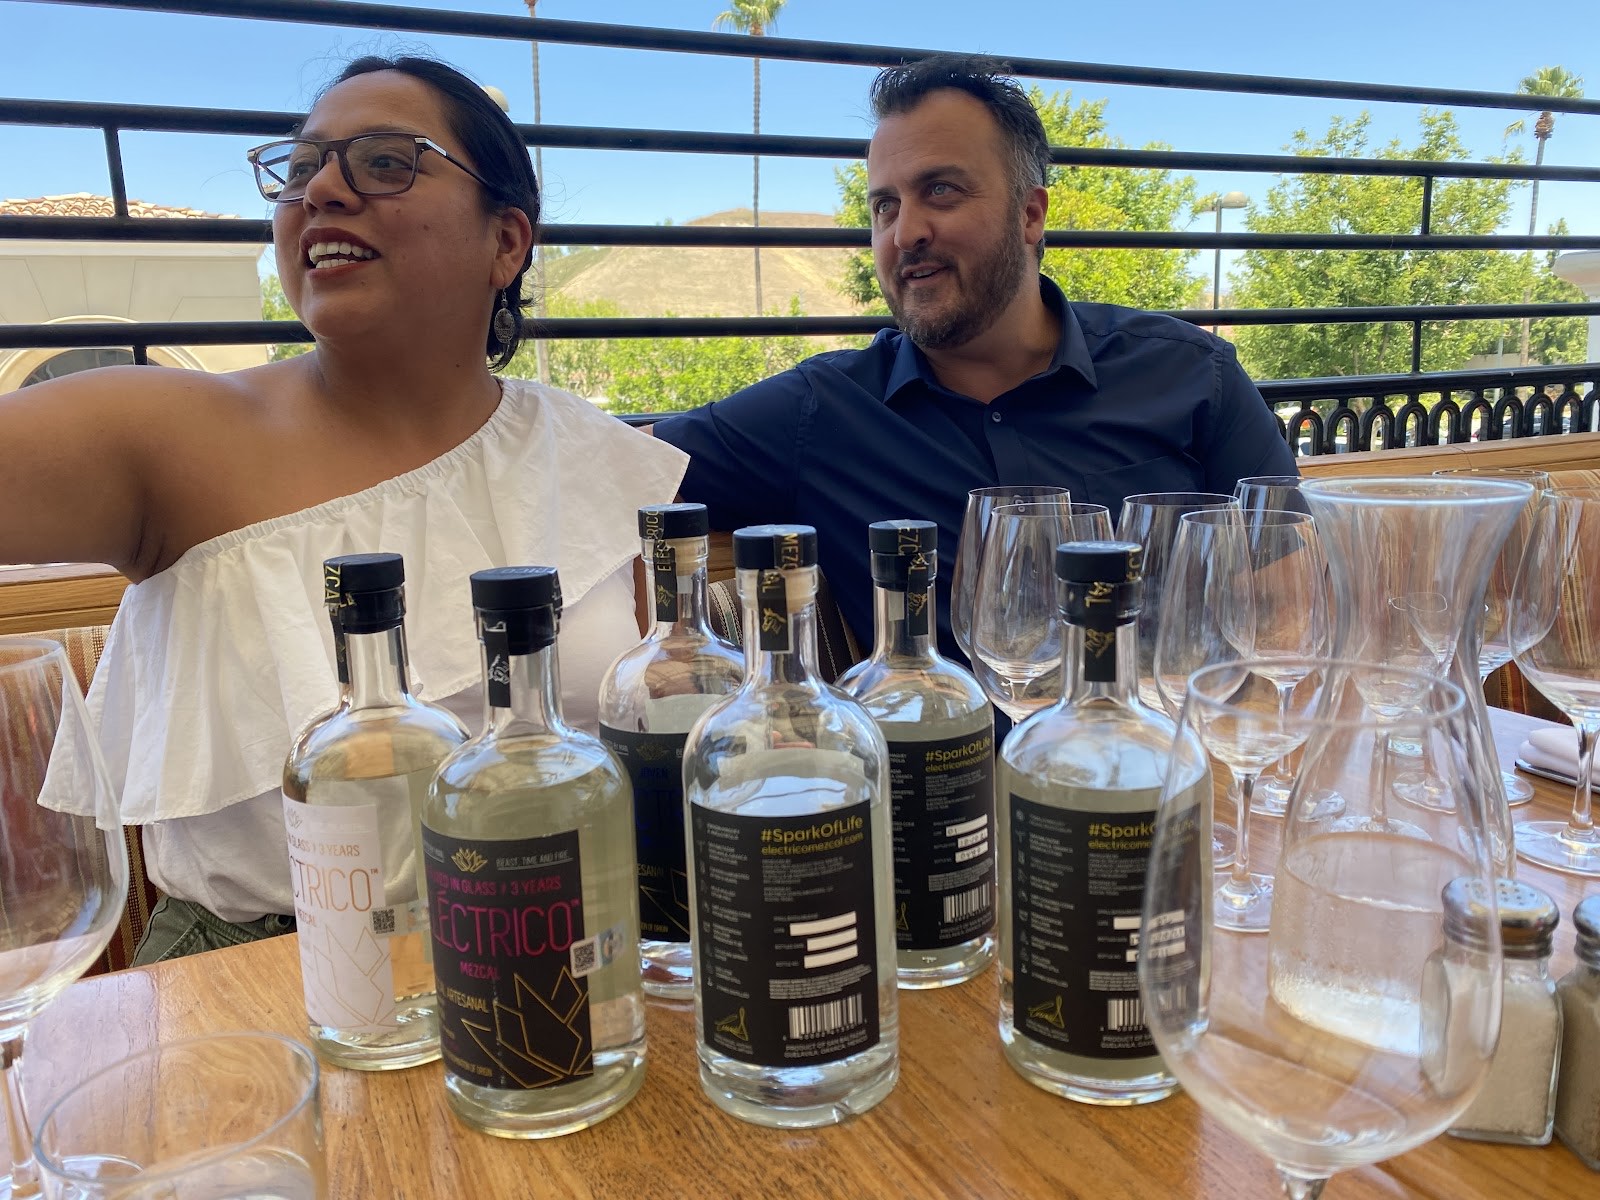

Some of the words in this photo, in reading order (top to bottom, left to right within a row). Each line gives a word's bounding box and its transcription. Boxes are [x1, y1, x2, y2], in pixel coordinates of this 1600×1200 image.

[924, 736, 991, 763] #SparkOfLife
[761, 815, 864, 845] #SparkOfLife
[327, 844, 360, 857] YEARS
[761, 832, 864, 856] electricomezcal.com
[461, 879, 497, 896] GLASS
[510, 881, 519, 896] 3
[521, 876, 562, 895] YEARS
[460, 960, 499, 980] MEZCAL
